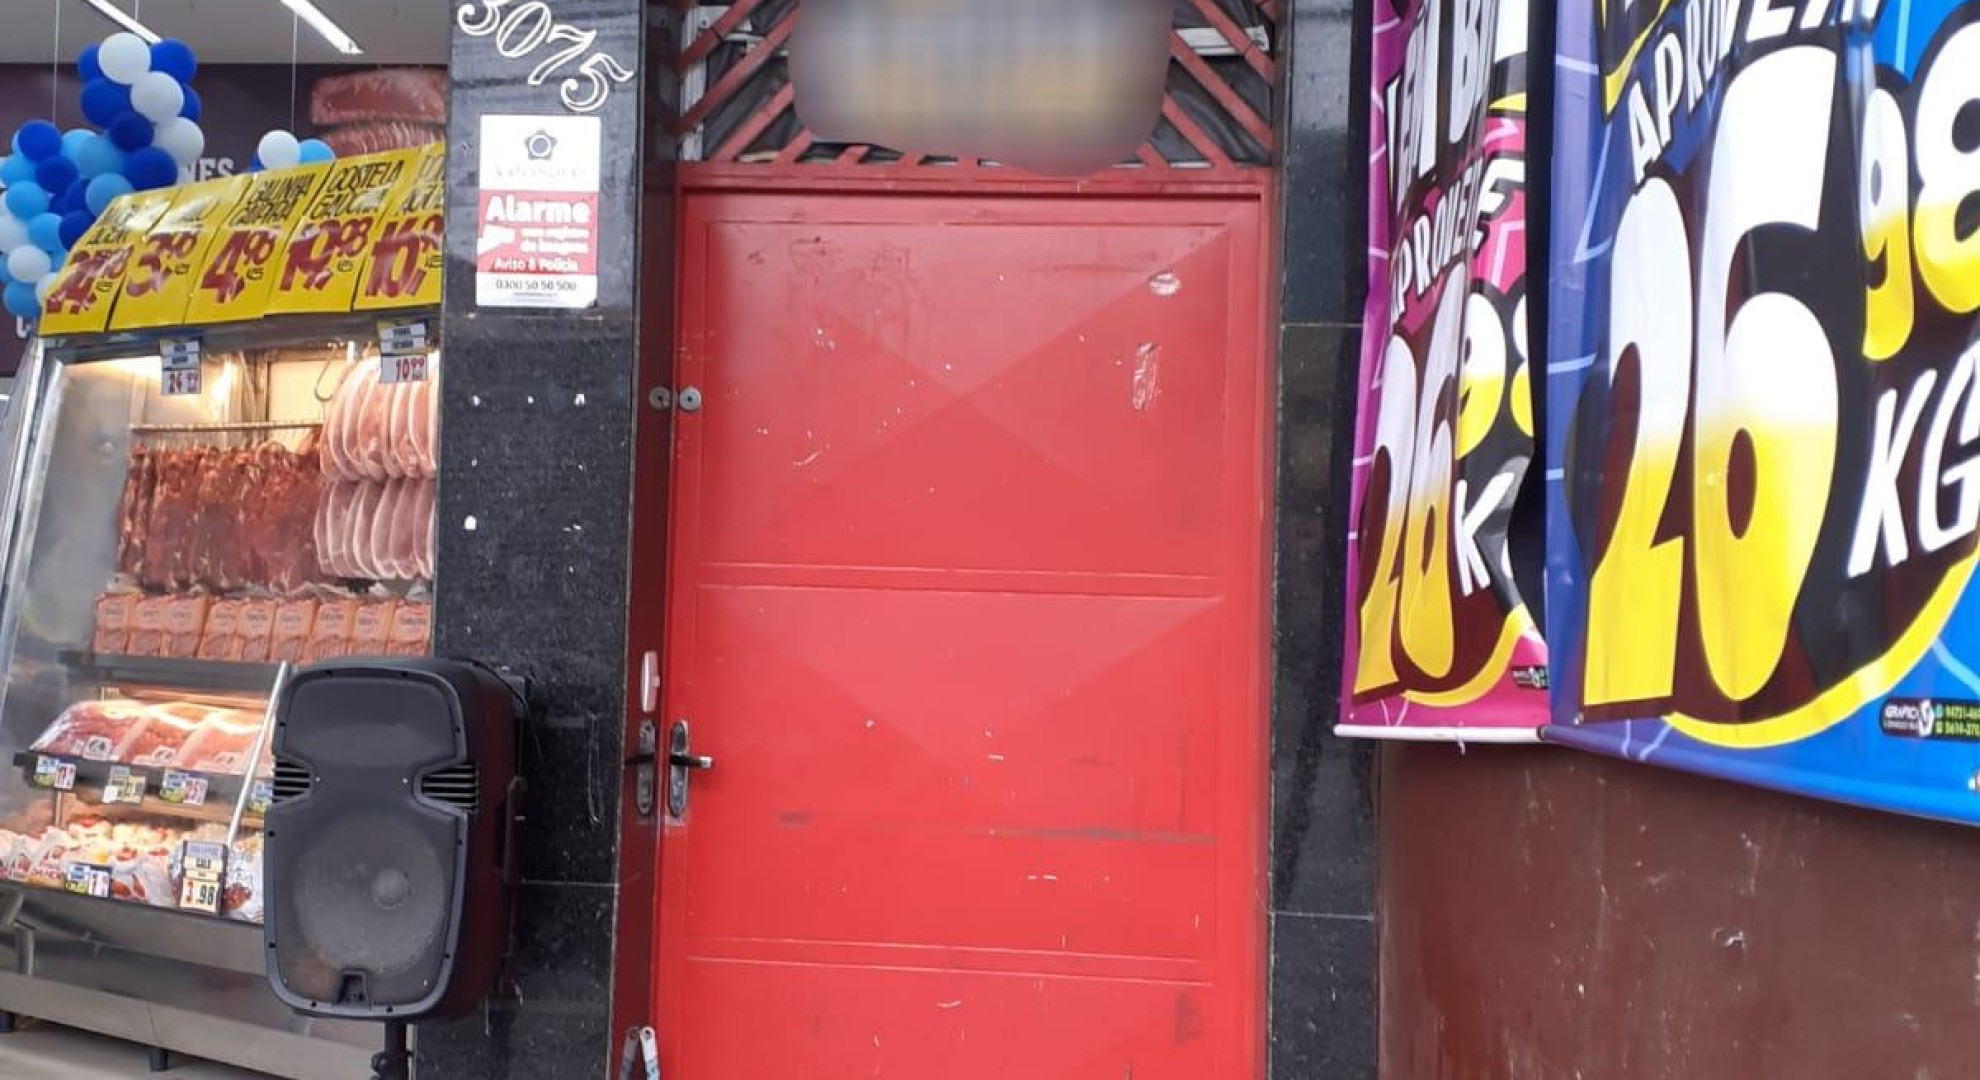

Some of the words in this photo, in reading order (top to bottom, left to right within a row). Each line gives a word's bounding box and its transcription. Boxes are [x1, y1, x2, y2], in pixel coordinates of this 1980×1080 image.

[457, 0, 634, 112] 3075
[486, 193, 590, 223] Alarme
[1583, 45, 1840, 706] 26
[1859, 20, 1980, 361] 98
[1454, 456, 1532, 597] K
[1847, 343, 1980, 578] KG
